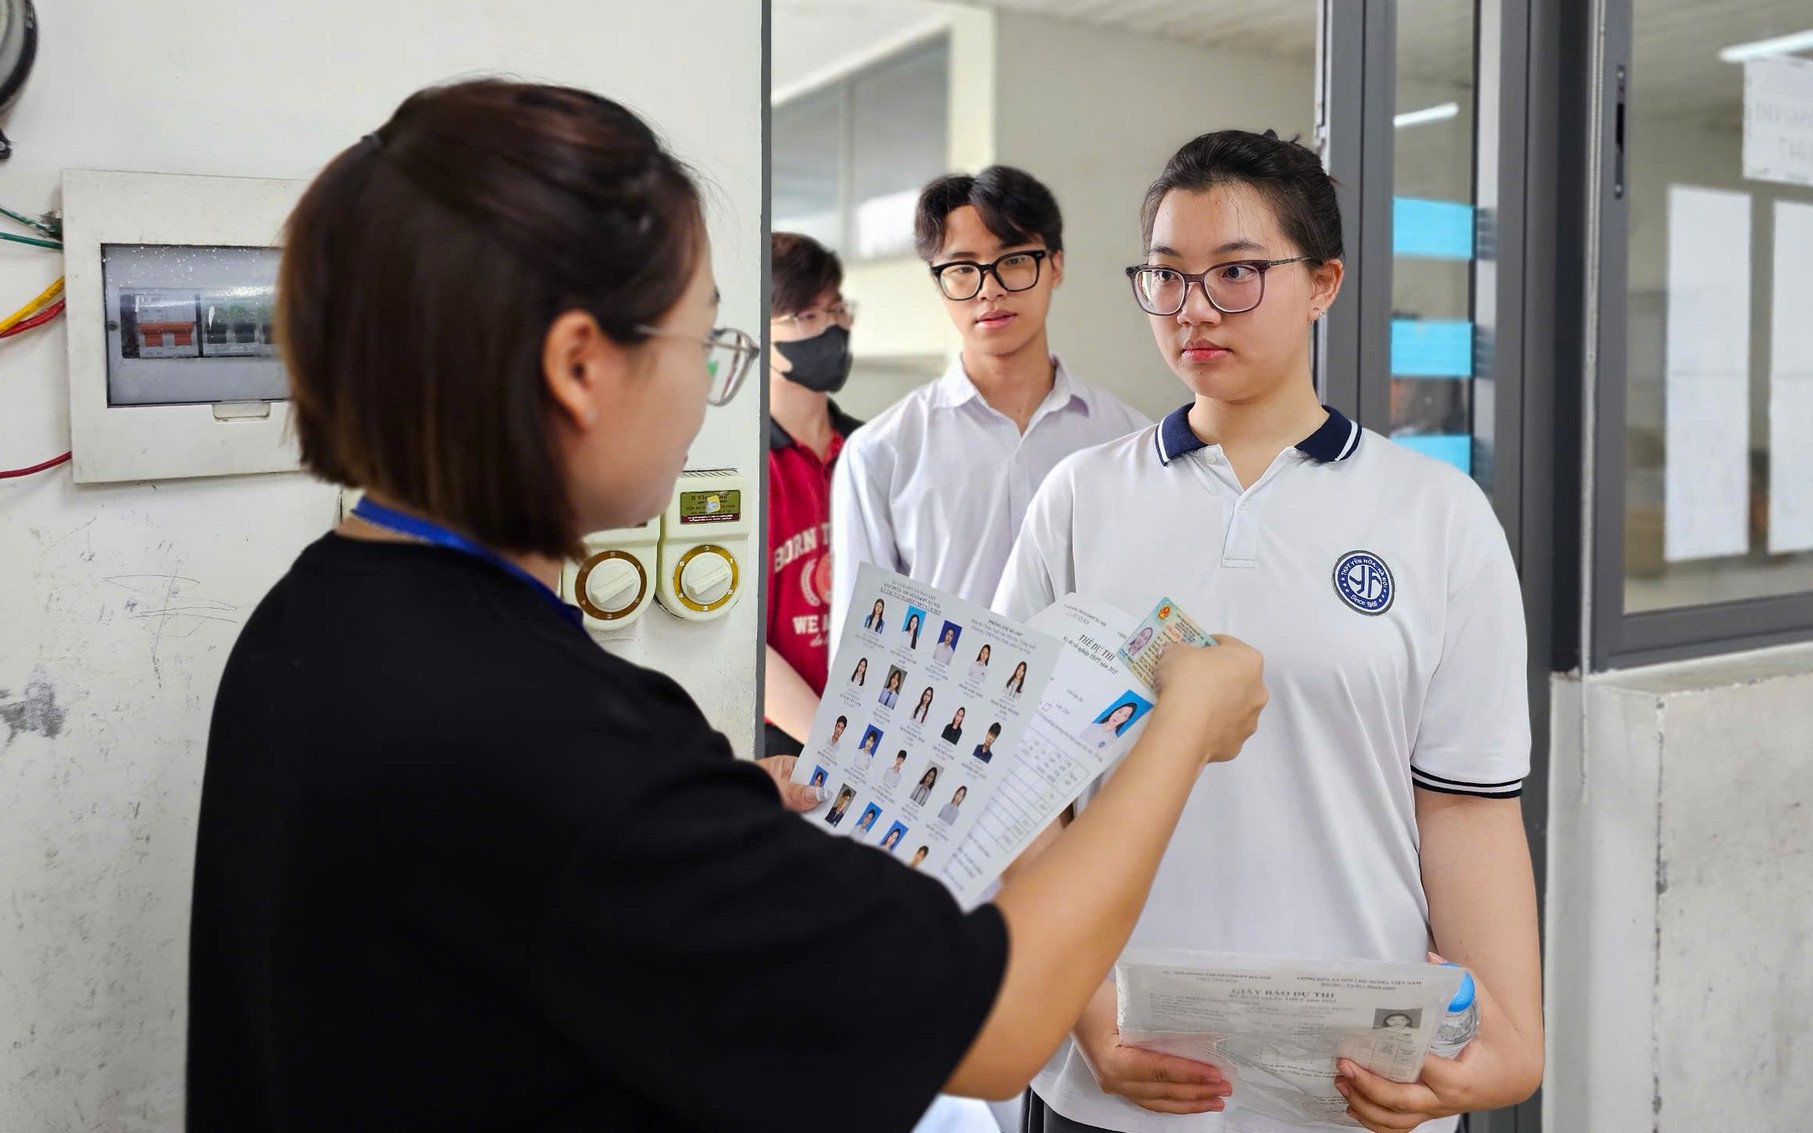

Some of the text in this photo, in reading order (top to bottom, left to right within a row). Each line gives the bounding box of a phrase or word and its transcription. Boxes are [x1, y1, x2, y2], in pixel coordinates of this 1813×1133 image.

[774, 527, 817, 574] BORN
[1363, 557, 1376, 568] HÒA
[1350, 594, 1366, 605] Since
[792, 615, 819, 634] WE
[1078, 633, 1116, 662] THẺ DỰ THI
[1265, 987, 1290, 998] BÁO
[1291, 988, 1312, 999] DỰ
[1314, 990, 1335, 999] THI
